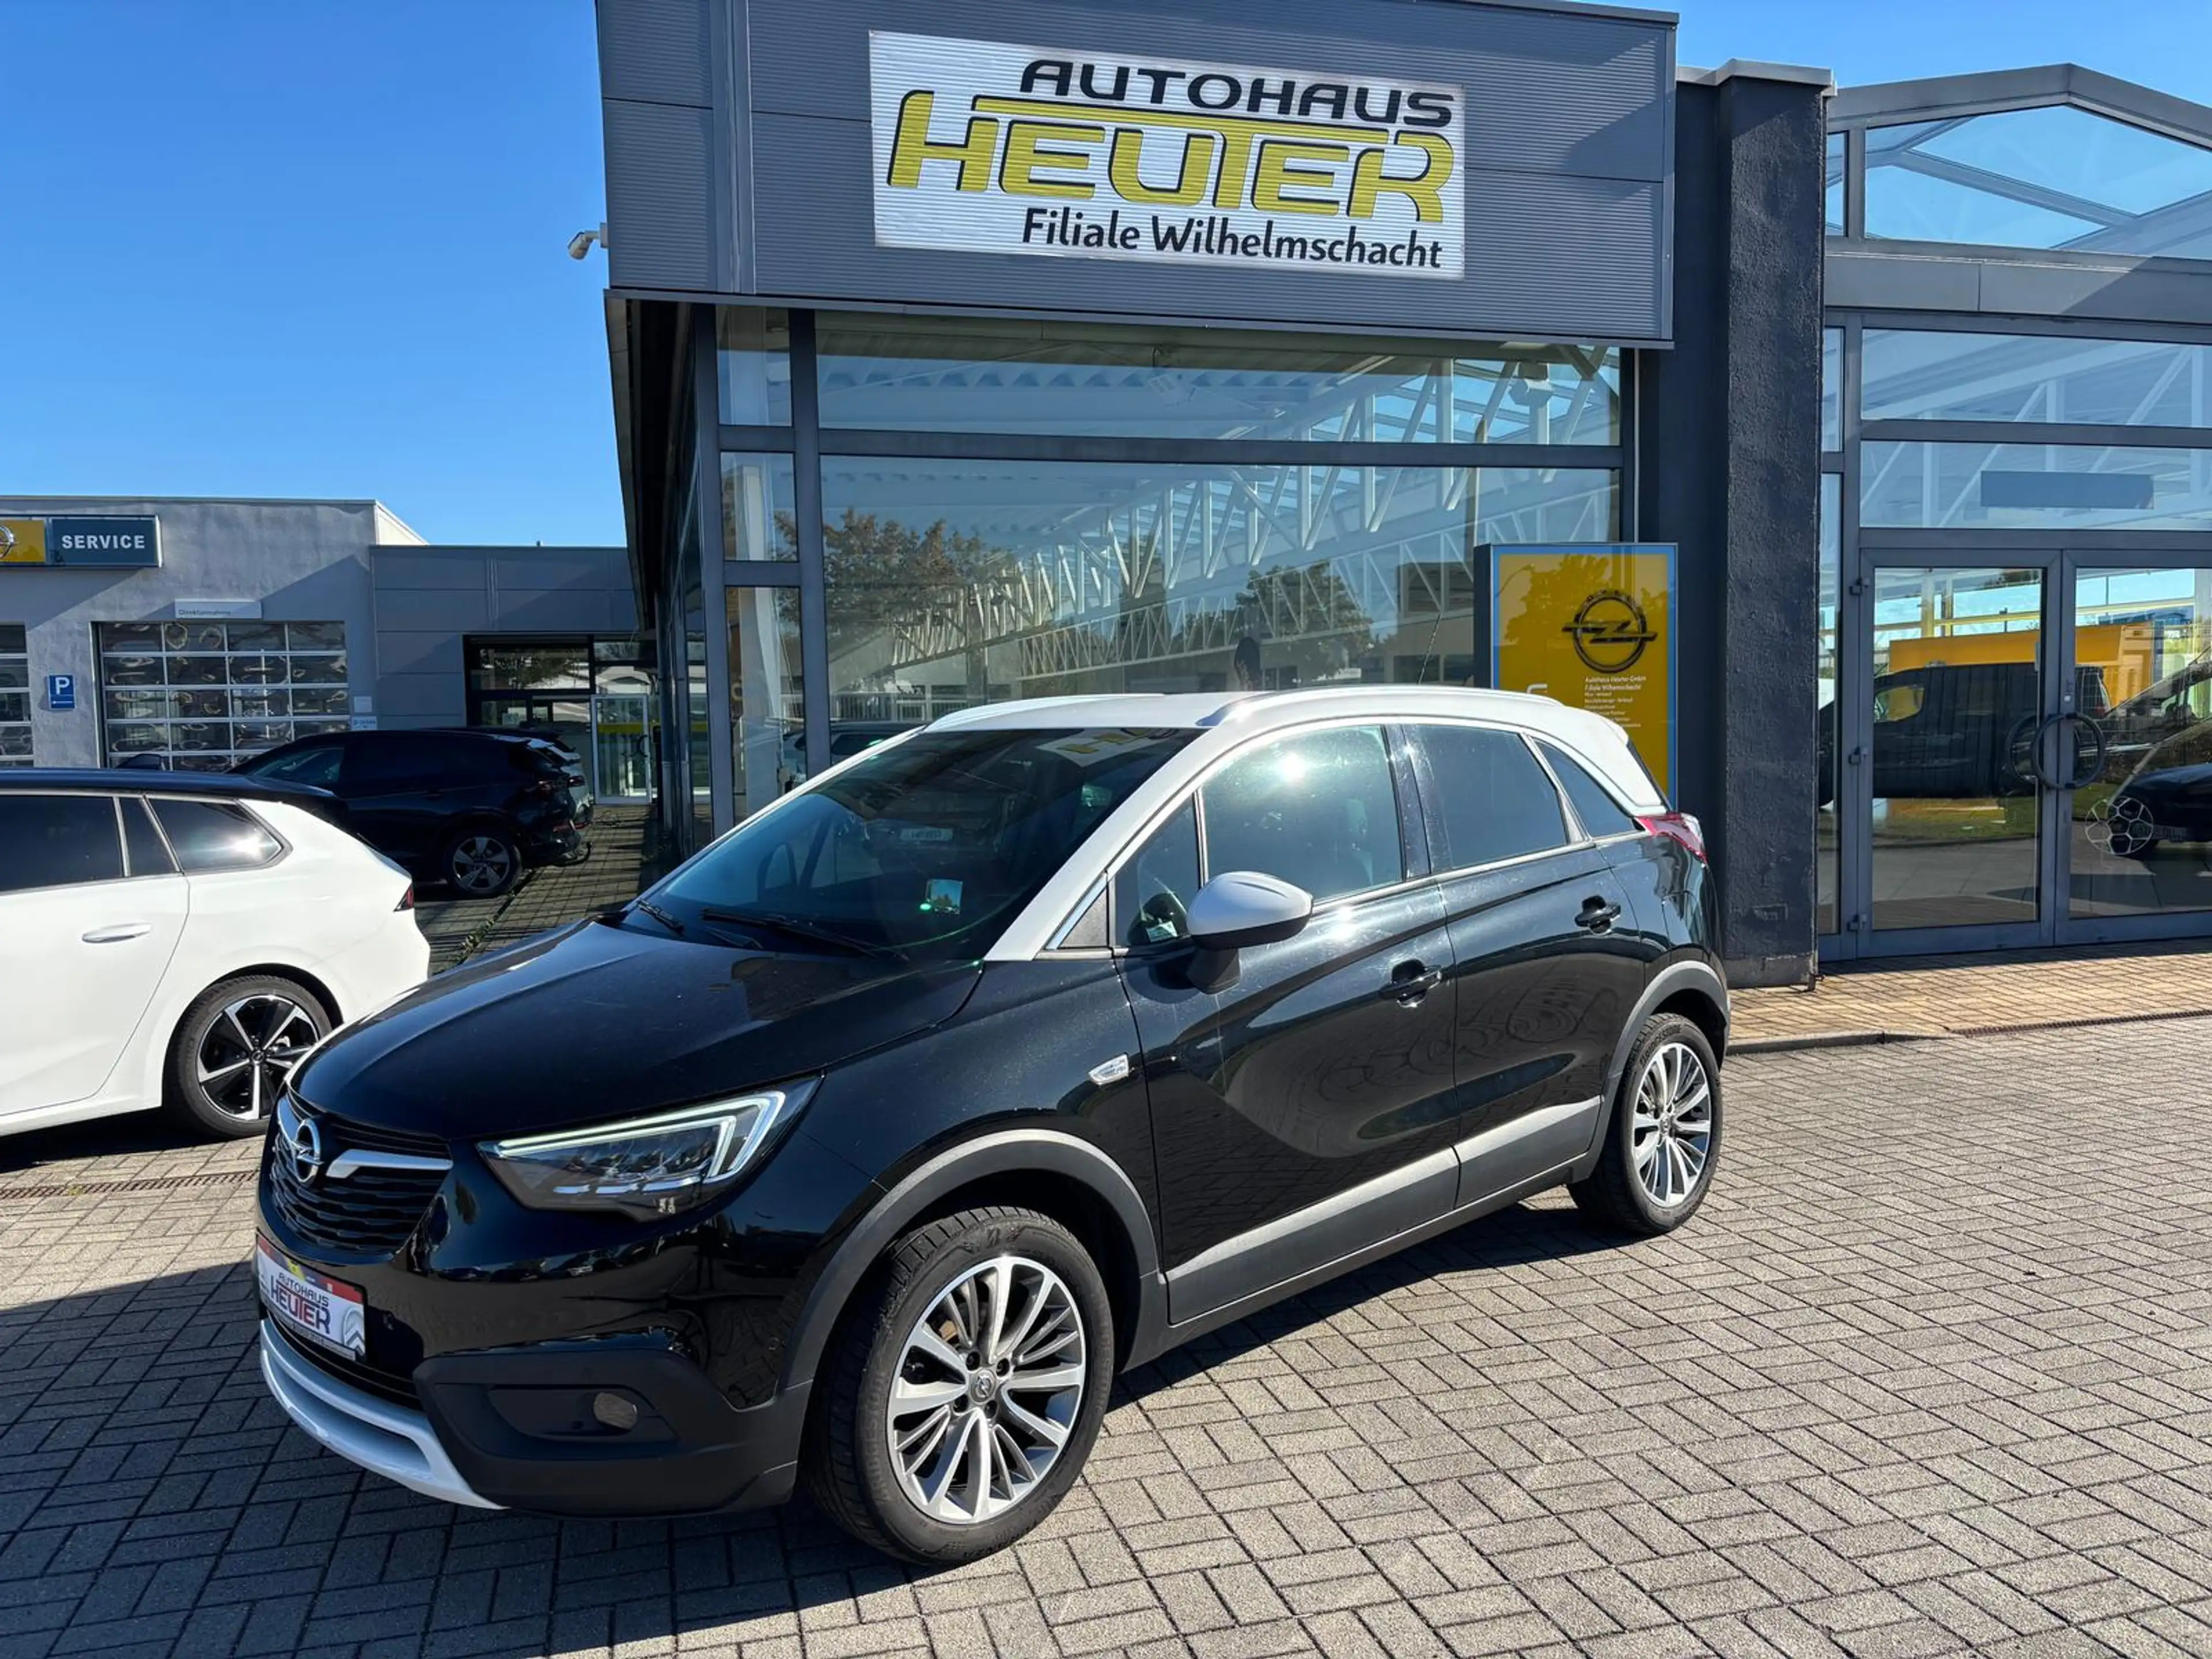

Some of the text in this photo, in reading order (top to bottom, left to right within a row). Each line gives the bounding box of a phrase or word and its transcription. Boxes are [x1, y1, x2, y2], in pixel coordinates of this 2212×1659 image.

[1020, 59, 1454, 127] AUTOHAUS
[887, 90, 1454, 222] HEUTER
[1022, 208, 1442, 268] Filiale Wilhelmschacht
[62, 535, 145, 549] SERVICE
[55, 677, 70, 695] P
[271, 1275, 331, 1335] HEUTER
[278, 1272, 329, 1308] AUTOHAUS
